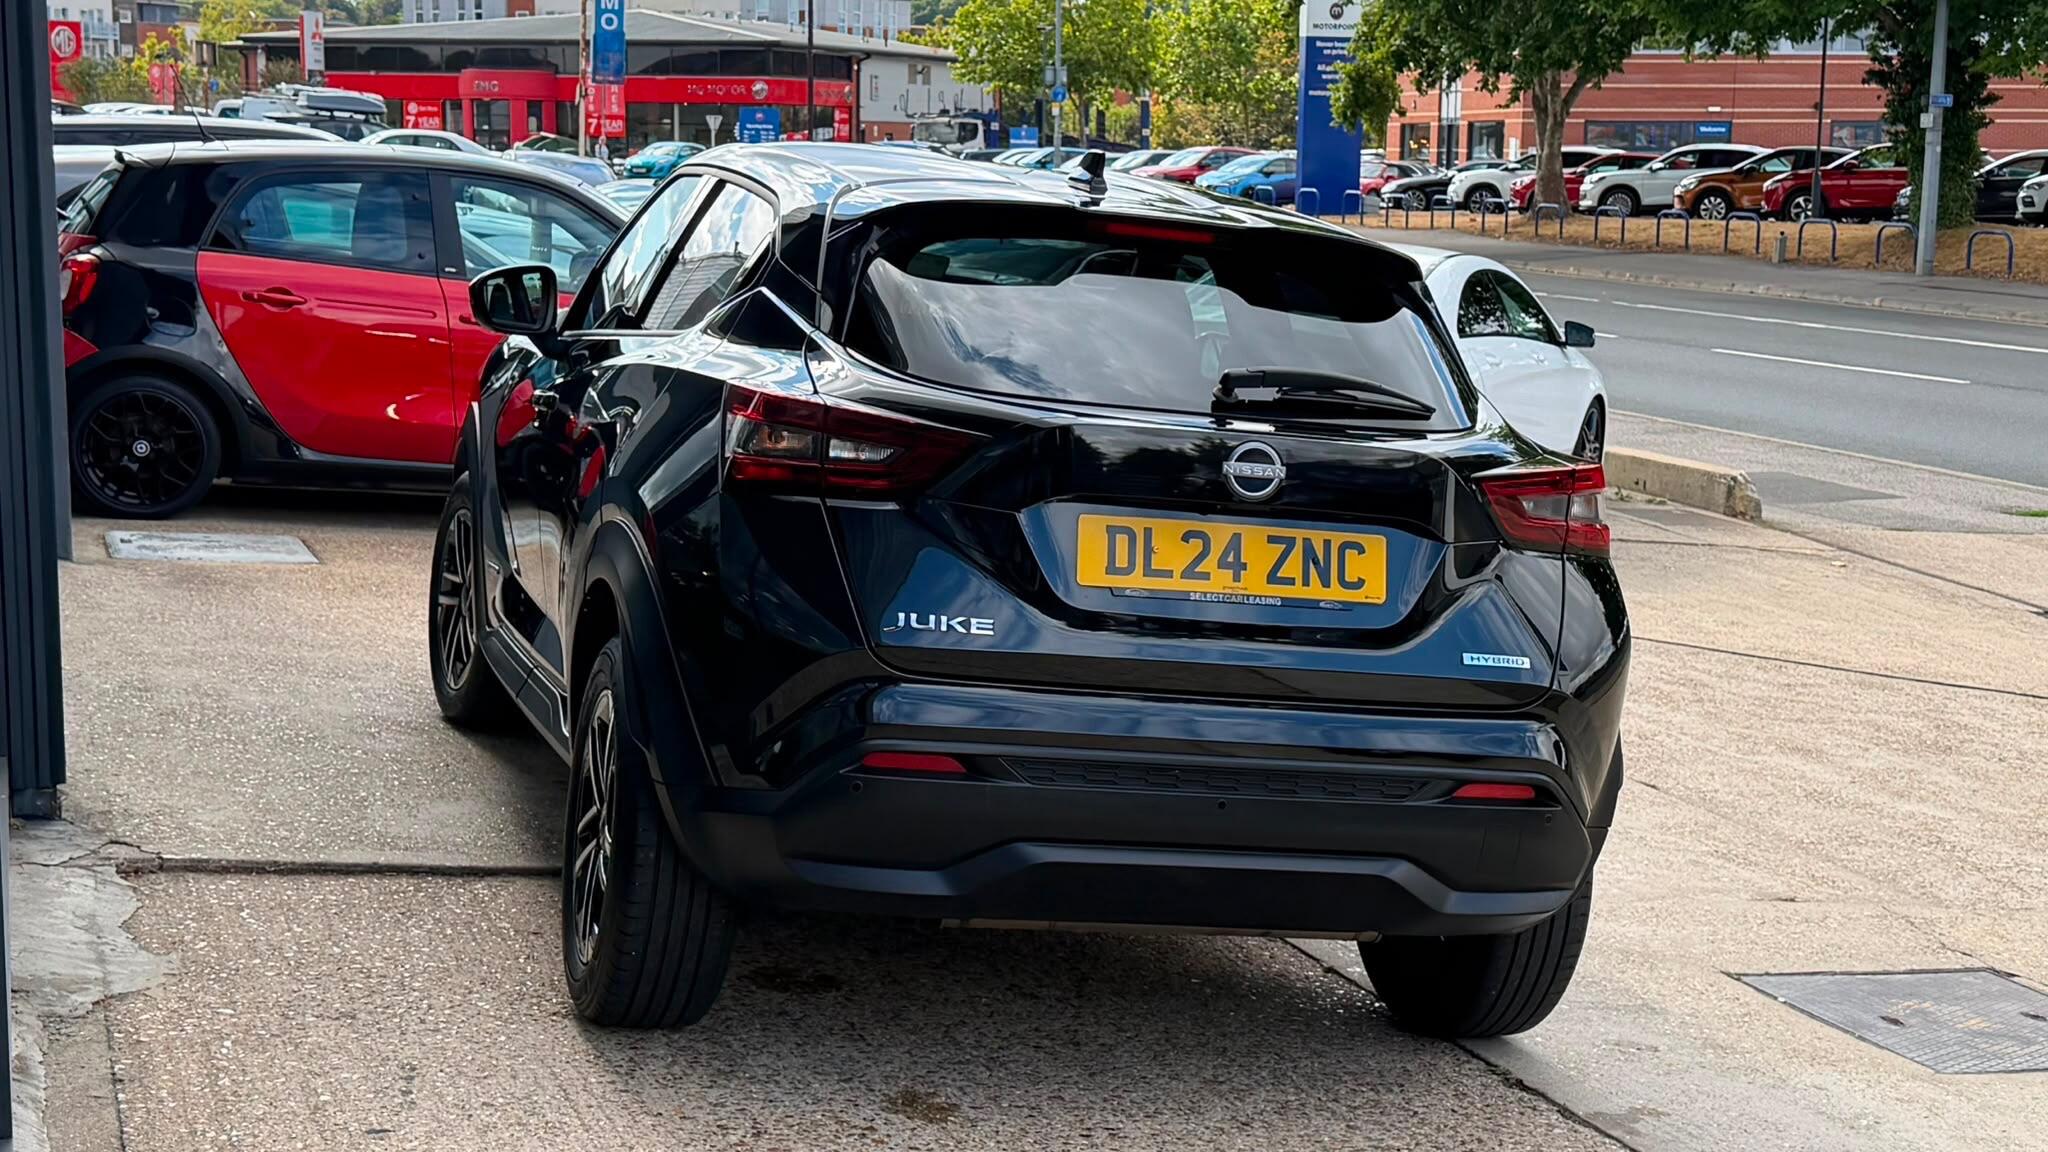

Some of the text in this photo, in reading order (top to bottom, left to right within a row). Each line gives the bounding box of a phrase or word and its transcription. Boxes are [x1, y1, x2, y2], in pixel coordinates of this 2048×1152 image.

[54, 29, 75, 54] MG
[707, 84, 747, 96] MOTOR
[1223, 464, 1285, 478] NISSAN
[1105, 524, 1367, 591] DL24 ZNC
[882, 612, 995, 635] JUKE
[1470, 655, 1525, 666] HYBRID
